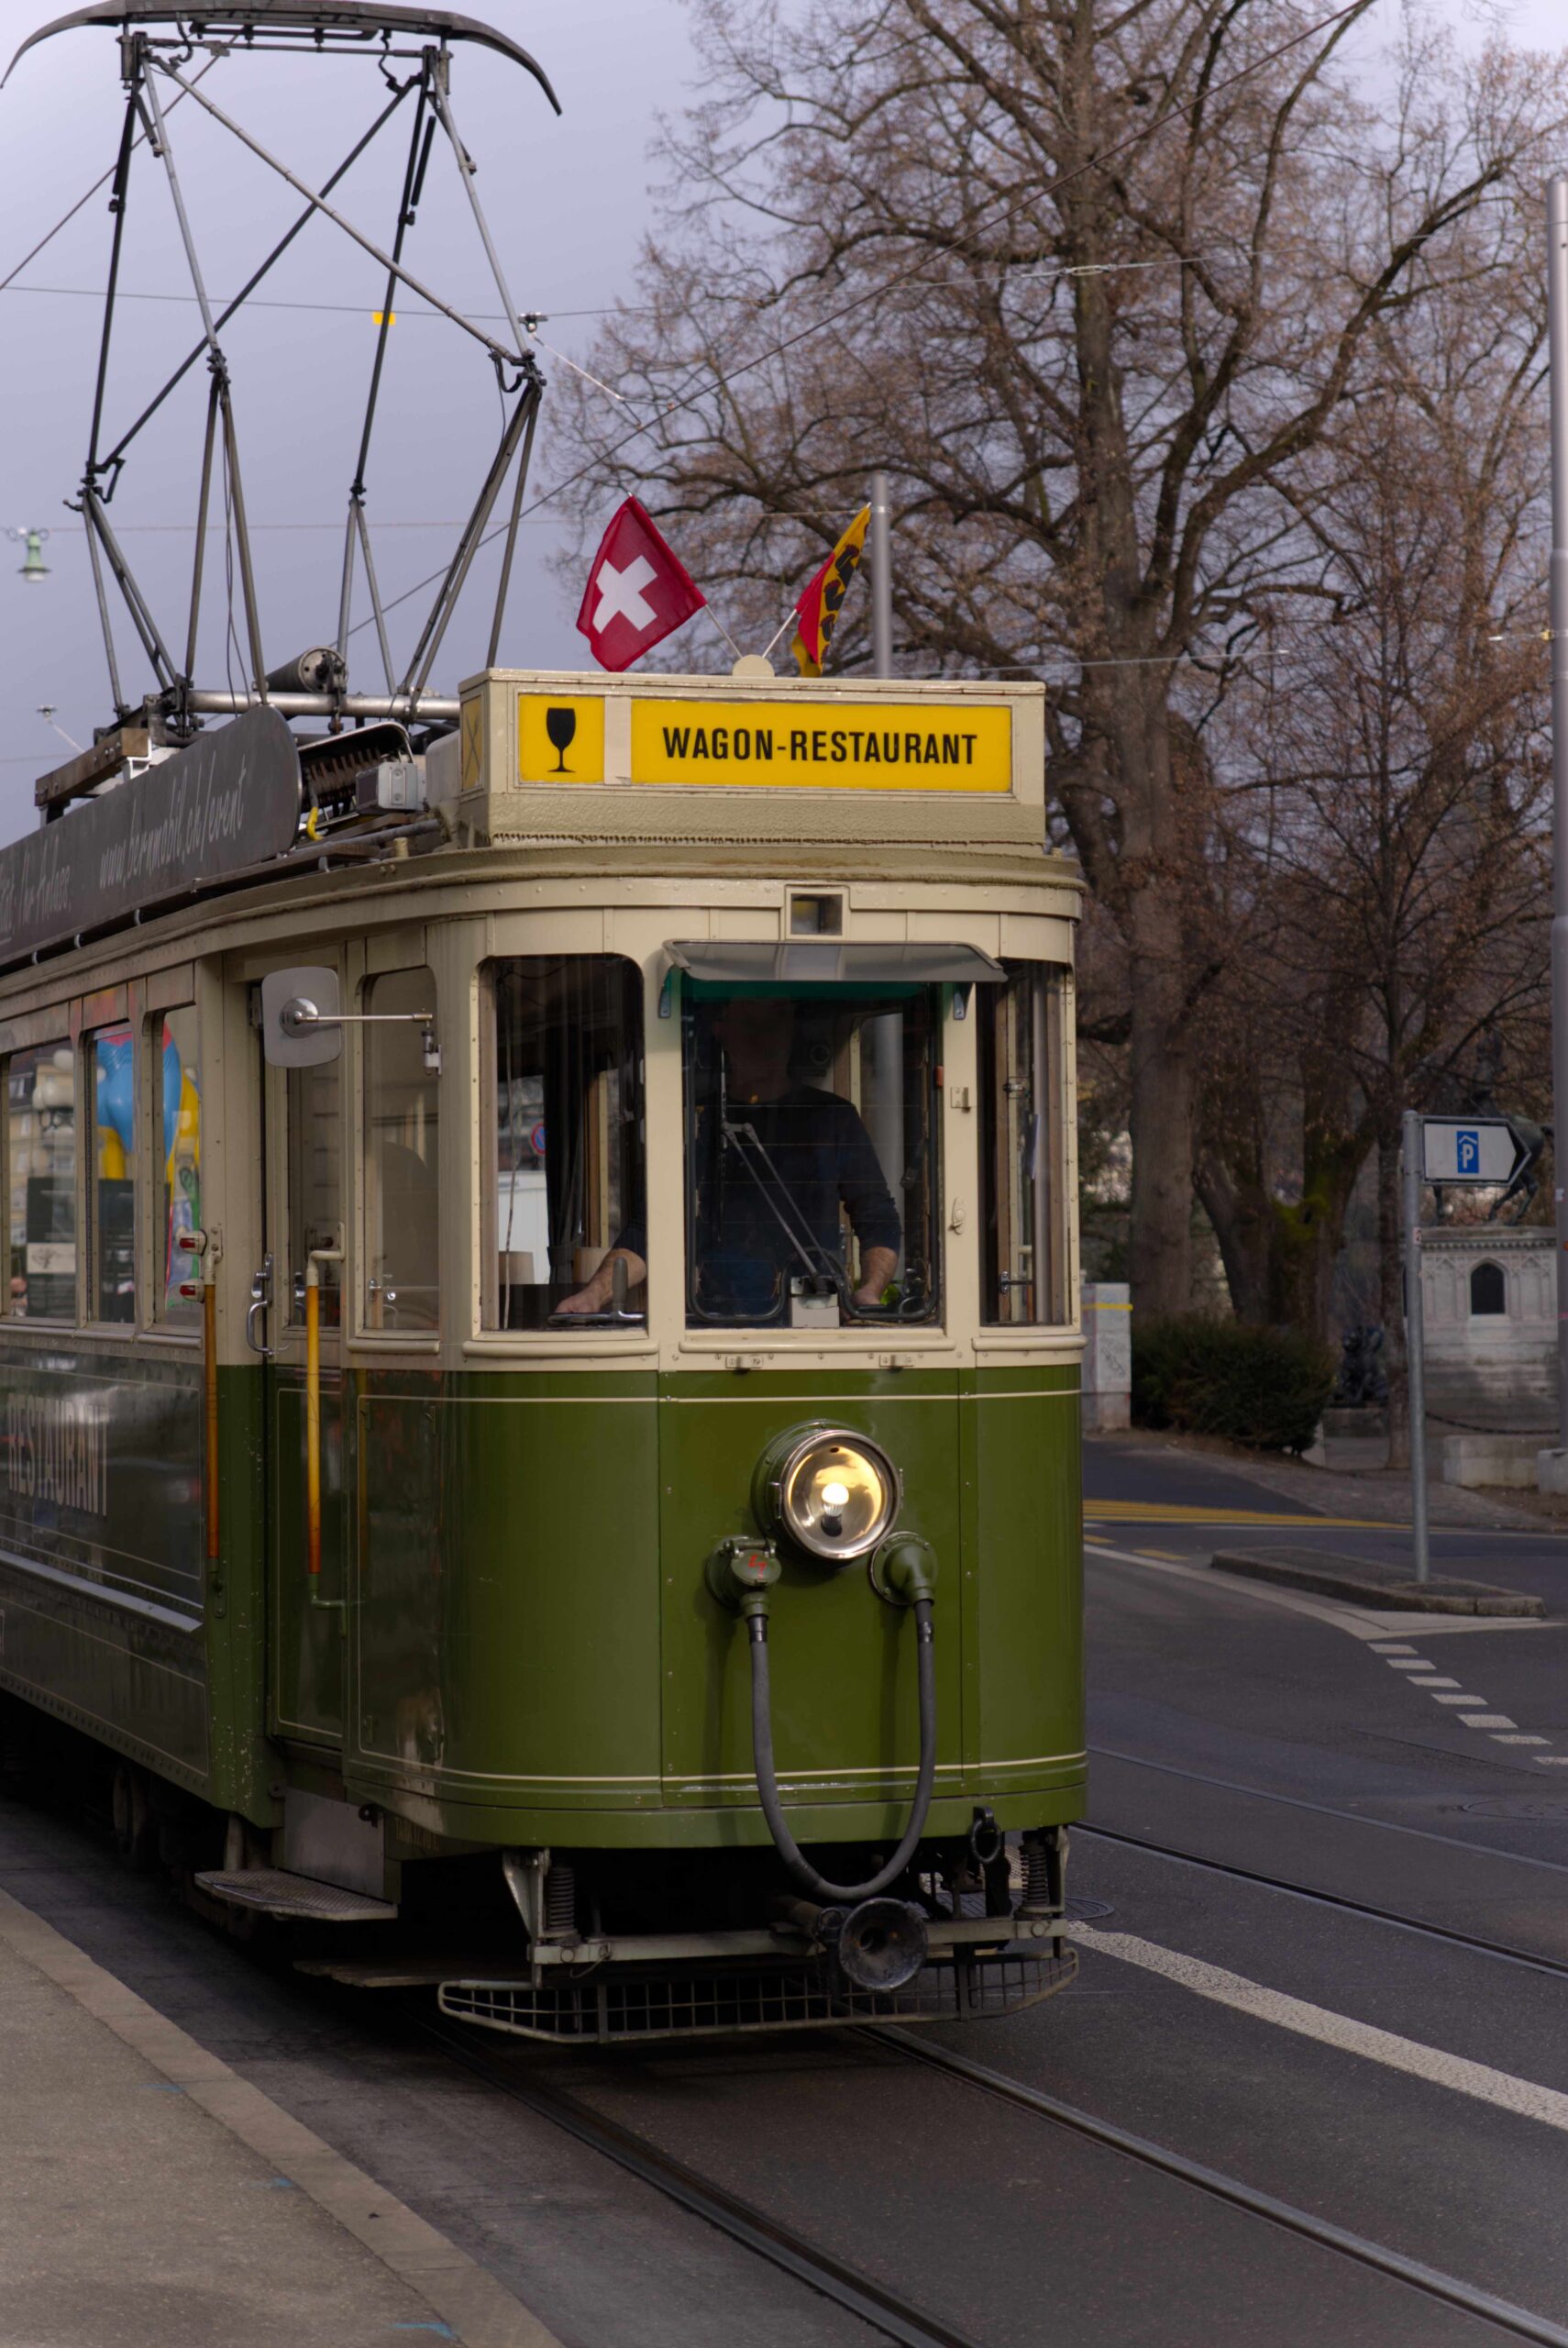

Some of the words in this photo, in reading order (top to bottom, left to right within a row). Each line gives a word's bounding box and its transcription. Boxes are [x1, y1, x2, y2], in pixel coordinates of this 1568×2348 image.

[662, 727, 977, 765] WAGON-RESTAURANT
[1462, 1143, 1474, 1169] P
[7, 1392, 109, 1516] RESTAURANT
